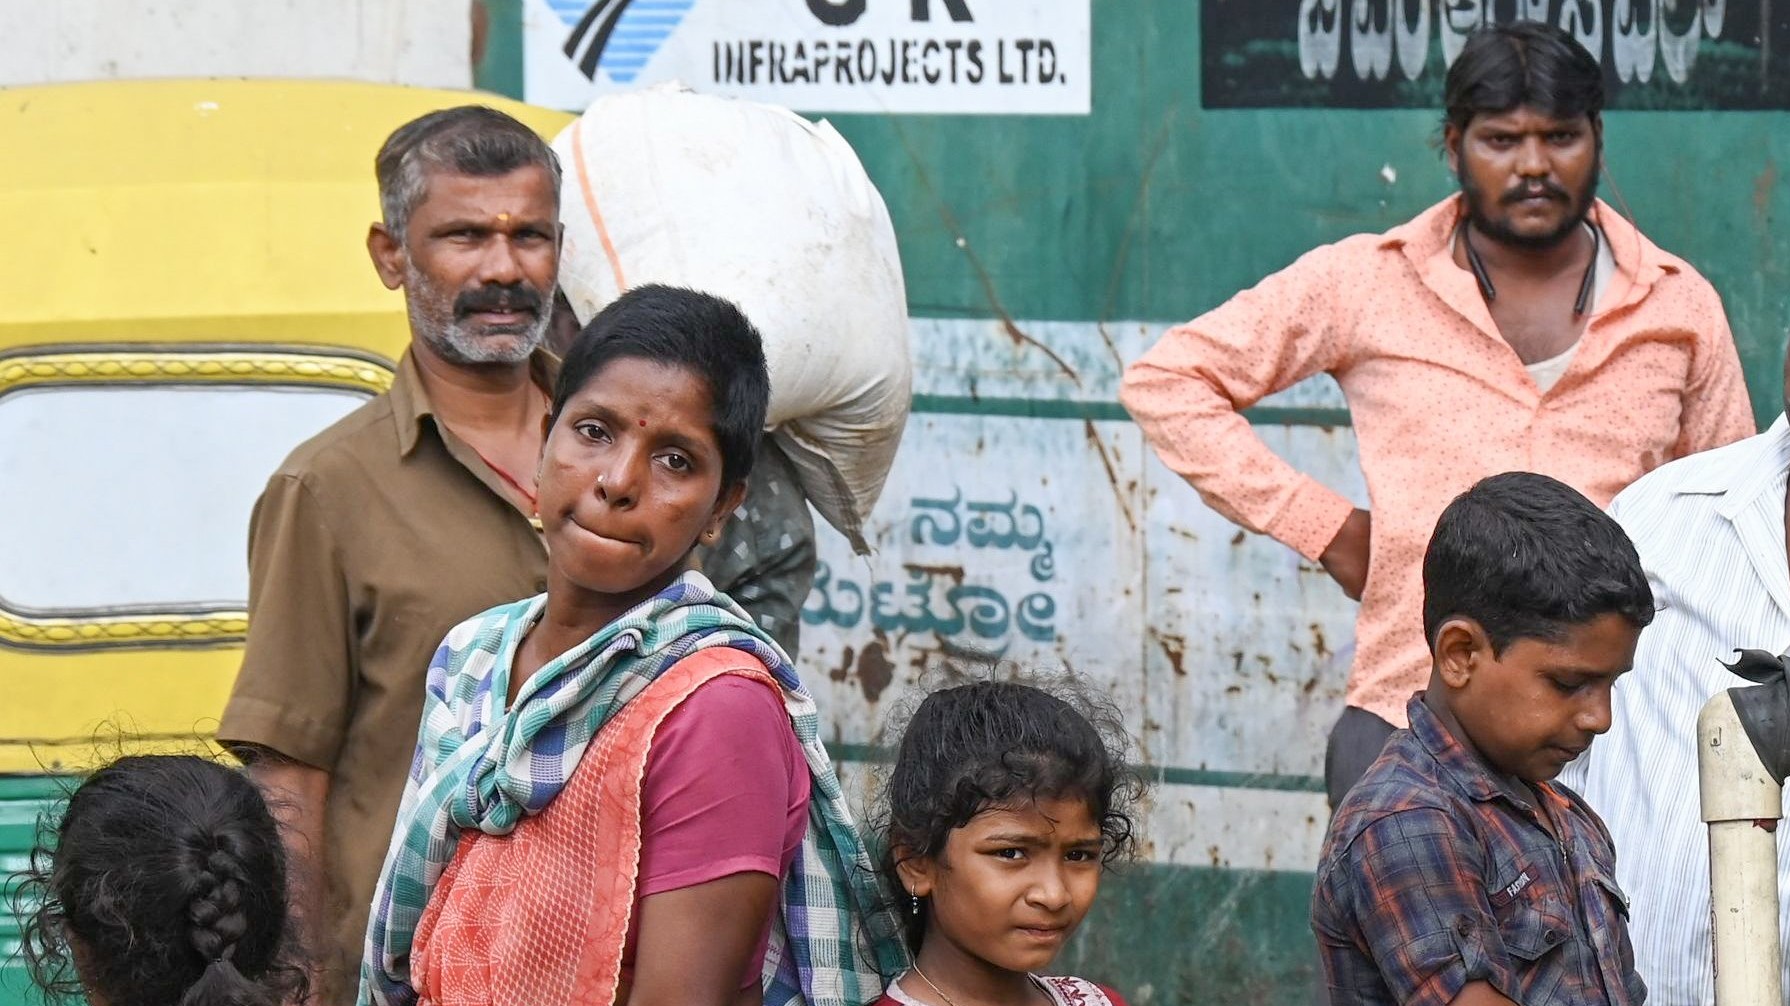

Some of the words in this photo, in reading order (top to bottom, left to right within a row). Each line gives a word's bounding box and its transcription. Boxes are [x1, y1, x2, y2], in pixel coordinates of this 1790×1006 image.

[713, 39, 984, 85] INFRAPROJECTS
[998, 39, 1065, 85] LTD.
[910, 483, 1055, 580] ನಮ್ಮ
